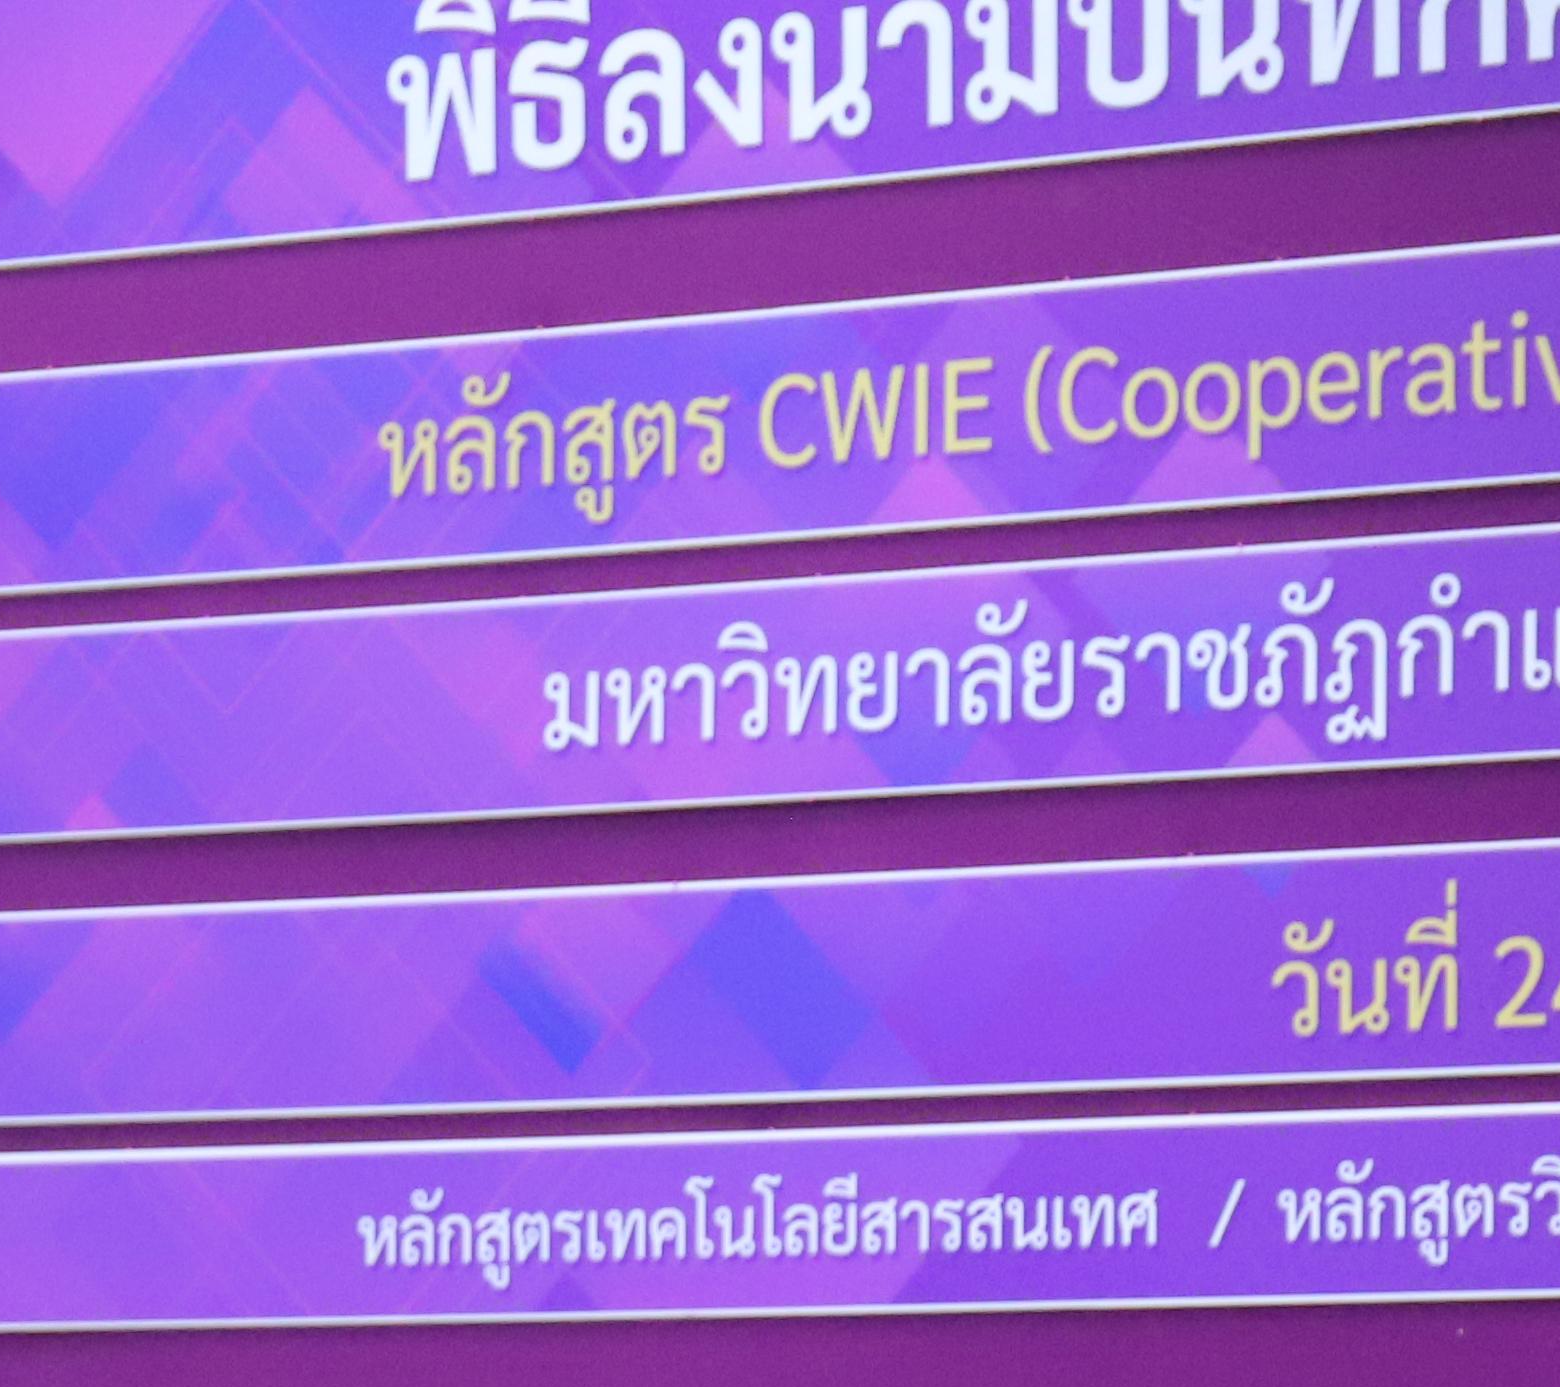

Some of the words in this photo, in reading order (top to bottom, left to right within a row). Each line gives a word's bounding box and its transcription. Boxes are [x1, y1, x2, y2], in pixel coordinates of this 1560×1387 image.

[377, 371, 731, 523] หลักสูตร
[758, 356, 994, 468] CWIE
[1271, 878, 1459, 1038] วันที่
[356, 1171, 1160, 1289] หลักสูตรเทคโนโลยีสารสนเทศ
